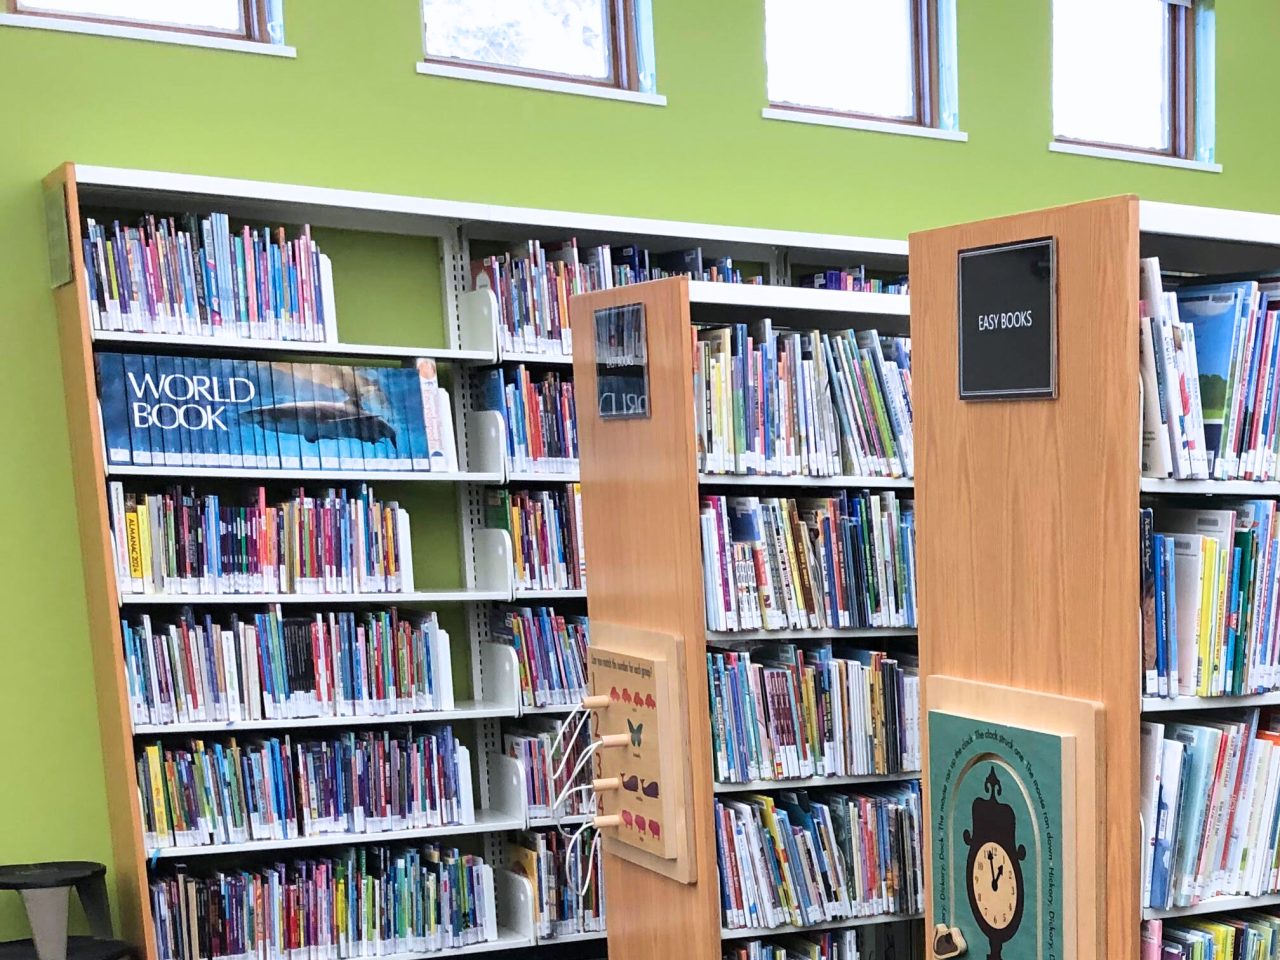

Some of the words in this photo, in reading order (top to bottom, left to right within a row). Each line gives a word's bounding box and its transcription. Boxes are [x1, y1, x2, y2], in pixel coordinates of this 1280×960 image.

[978, 314, 999, 331] EASY
[1002, 310, 1032, 328] BOOKS
[128, 372, 255, 403] WORLD
[132, 402, 228, 431] BOOK
[128, 518, 138, 556] ALMANAC
[592, 711, 600, 738] 2
[985, 729, 998, 739] clock
[1033, 780, 1045, 811] mouse
[1047, 867, 1055, 908] Hickory,
